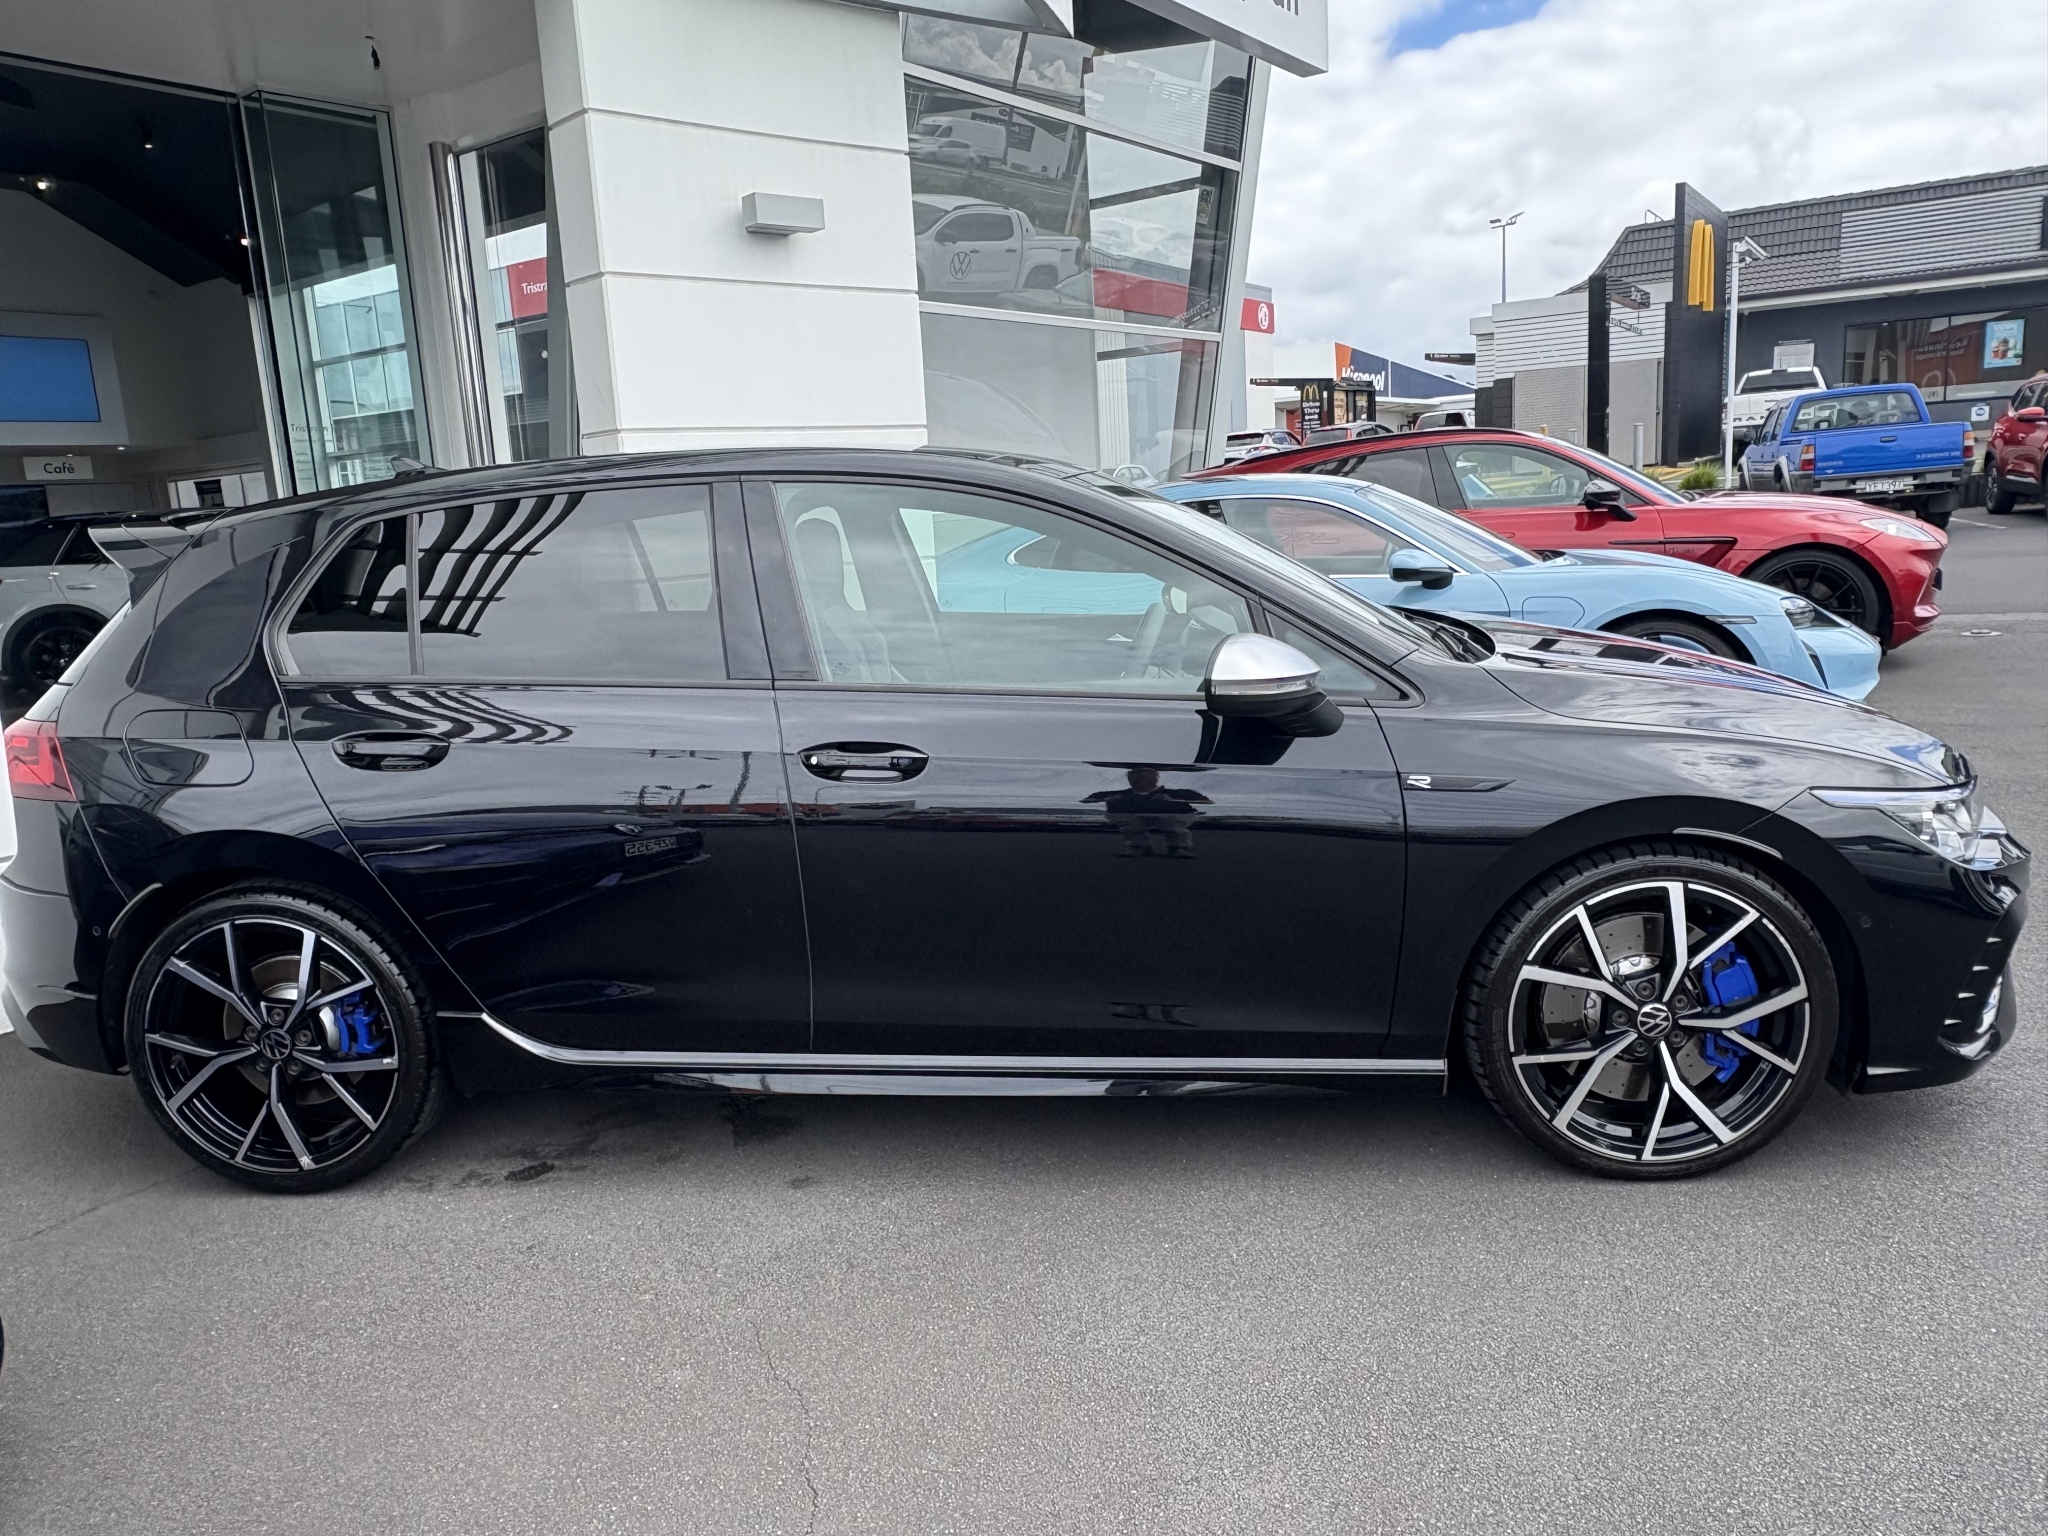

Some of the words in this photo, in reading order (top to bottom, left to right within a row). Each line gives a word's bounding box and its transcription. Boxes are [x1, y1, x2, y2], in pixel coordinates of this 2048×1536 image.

[291, 423, 329, 432] Trisr
[43, 462, 74, 473] Café
[1407, 775, 1431, 788] R
